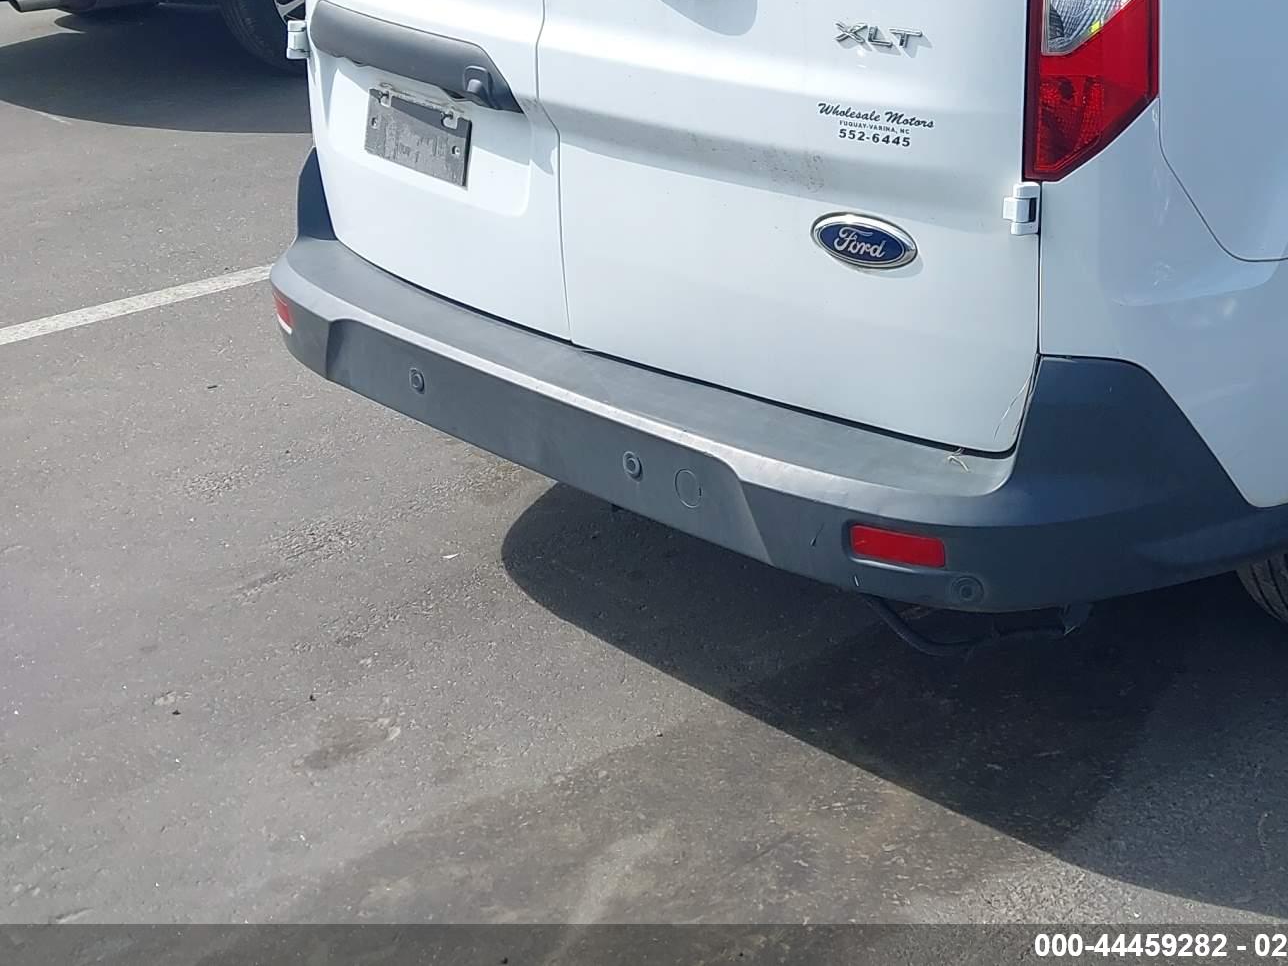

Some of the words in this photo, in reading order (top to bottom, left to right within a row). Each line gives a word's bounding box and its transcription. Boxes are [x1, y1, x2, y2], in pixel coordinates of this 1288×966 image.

[834, 21, 924, 49] XLT
[818, 103, 881, 121] Wholesale
[884, 111, 935, 129] Motors
[838, 128, 911, 147] 552-6445
[833, 225, 886, 258] Ford
